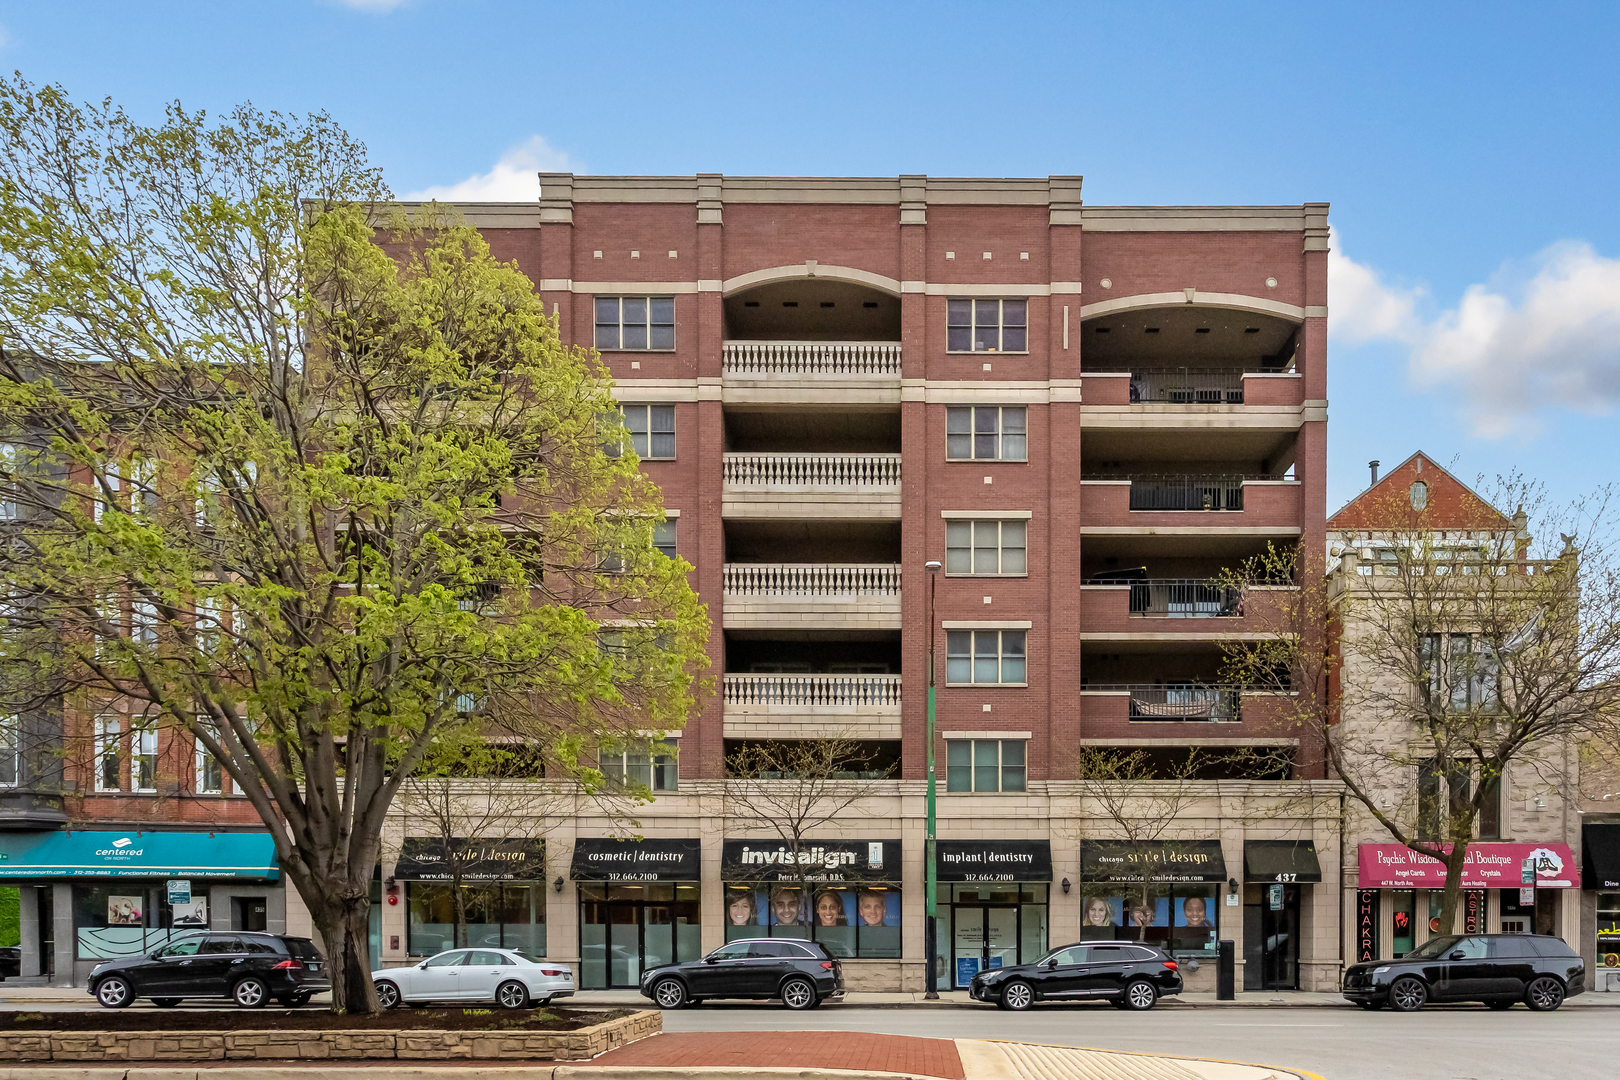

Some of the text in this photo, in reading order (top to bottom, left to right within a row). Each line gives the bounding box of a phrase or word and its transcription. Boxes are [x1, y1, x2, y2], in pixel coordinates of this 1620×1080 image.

[95, 848, 144, 856] centered
[588, 851, 684, 863] cosmetic dentistry
[741, 846, 857, 869] invisalign
[943, 851, 1033, 864] implant dentistry
[1170, 850, 1208, 864] design
[1377, 850, 1406, 867] Psychic
[1475, 850, 1512, 867] Boutique
[608, 872, 658, 881] 312.664.2100
[964, 873, 1014, 881] 312.664.2100
[1275, 873, 1297, 882] 437
[1395, 869, 1426, 878] Angel Cards
[1436, 869, 1448, 877] Lov
[1480, 869, 1501, 878] Crystals
[1466, 892, 1478, 933] ASTRO
[1361, 892, 1372, 961] CHAKRA
